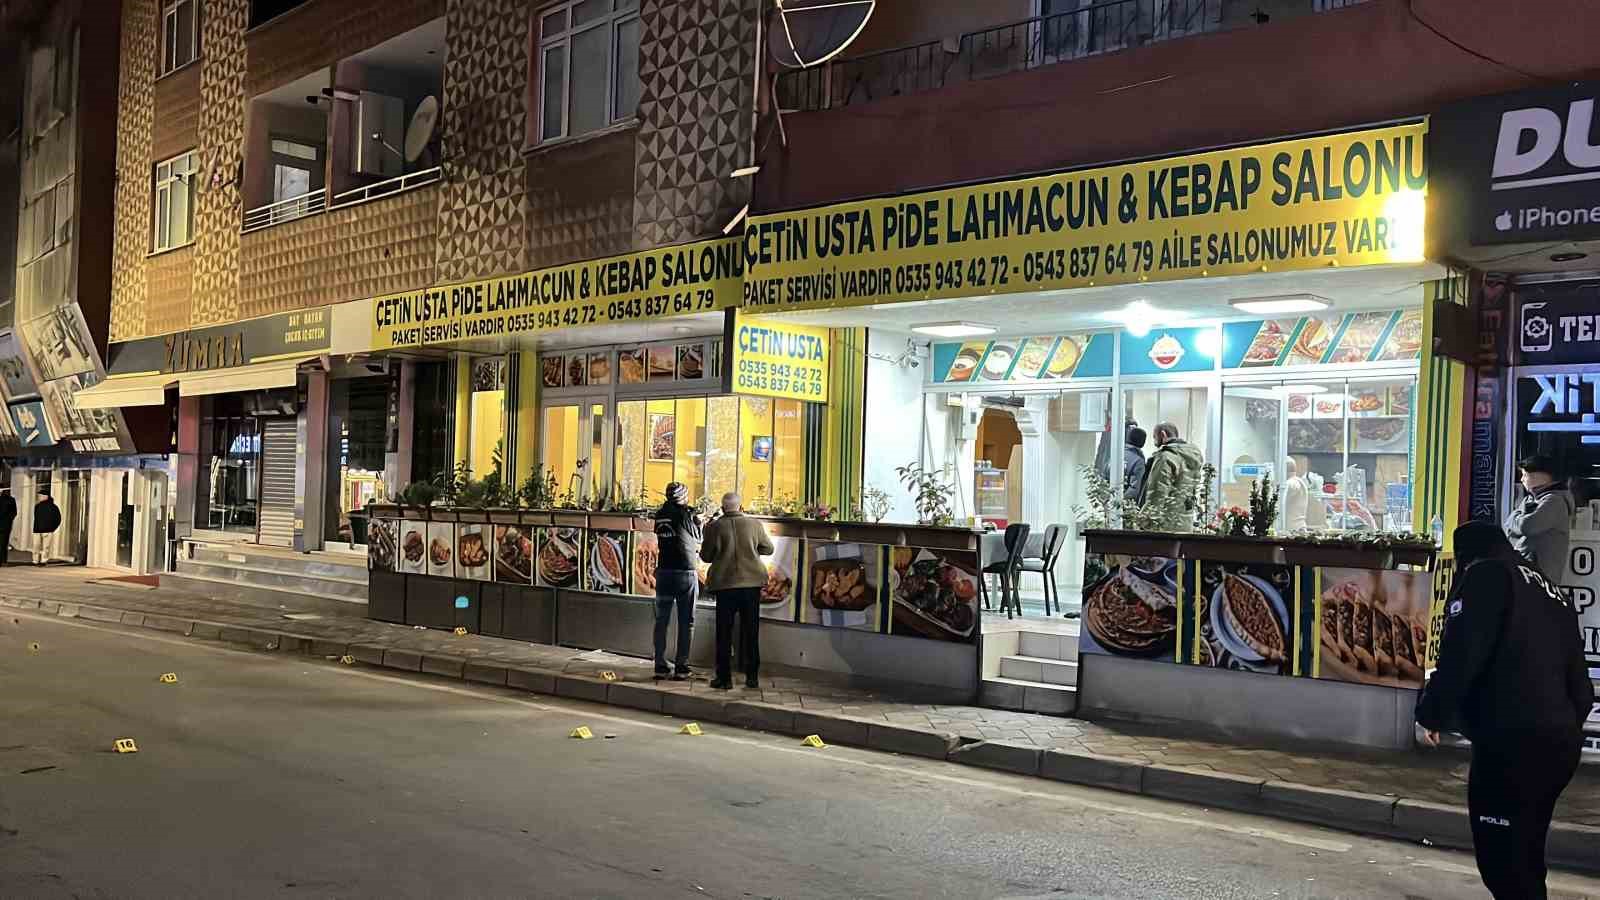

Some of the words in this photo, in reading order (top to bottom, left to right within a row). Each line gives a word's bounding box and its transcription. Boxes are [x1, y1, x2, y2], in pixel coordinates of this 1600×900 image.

[815, 209, 875, 258] USTA
[947, 175, 1108, 242] LAHMACUN
[1118, 172, 1138, 223] &
[1148, 157, 1261, 220] KEBAP
[1271, 135, 1427, 207] SALONU
[1519, 205, 1600, 229] iPhone
[744, 278, 783, 306] PAKET
[787, 266, 836, 303] SERVİSİ
[840, 267, 891, 298] VARDIR
[896, 264, 931, 293] 0535
[935, 260, 963, 290] 943
[967, 257, 986, 286] 42
[991, 255, 1008, 285] 72
[1023, 250, 1065, 282] 0543
[1070, 245, 1099, 278] 837
[1105, 242, 1127, 274] 64
[1132, 240, 1153, 272] 79
[1159, 229, 1201, 270] AİLE
[1207, 222, 1336, 266] SALONUMUZ
[415, 290, 448, 322] USTA
[487, 269, 575, 312] LAHMACUN
[579, 267, 591, 299] &
[596, 256, 656, 296] KEBAP
[661, 240, 744, 287] SALONU
[392, 327, 421, 345] PAKET
[424, 318, 461, 342] SERVİSİ
[465, 317, 504, 336] VARDIR
[508, 313, 534, 332] 0535
[538, 310, 560, 330] 943
[563, 307, 578, 325] 42
[582, 304, 596, 323] 72
[608, 300, 641, 320] 0543
[645, 296, 669, 316] 837
[674, 292, 691, 312] 64
[697, 288, 713, 309] 79
[788, 333, 823, 362] USTA
[738, 374, 767, 389] 0543
[770, 378, 789, 392] 837
[793, 380, 806, 394] 64
[809, 382, 821, 395] 79
[739, 360, 767, 375] 0535
[770, 363, 791, 377] 943
[794, 367, 807, 379] 42
[809, 368, 822, 381] 72
[119, 740, 132, 749] 16
